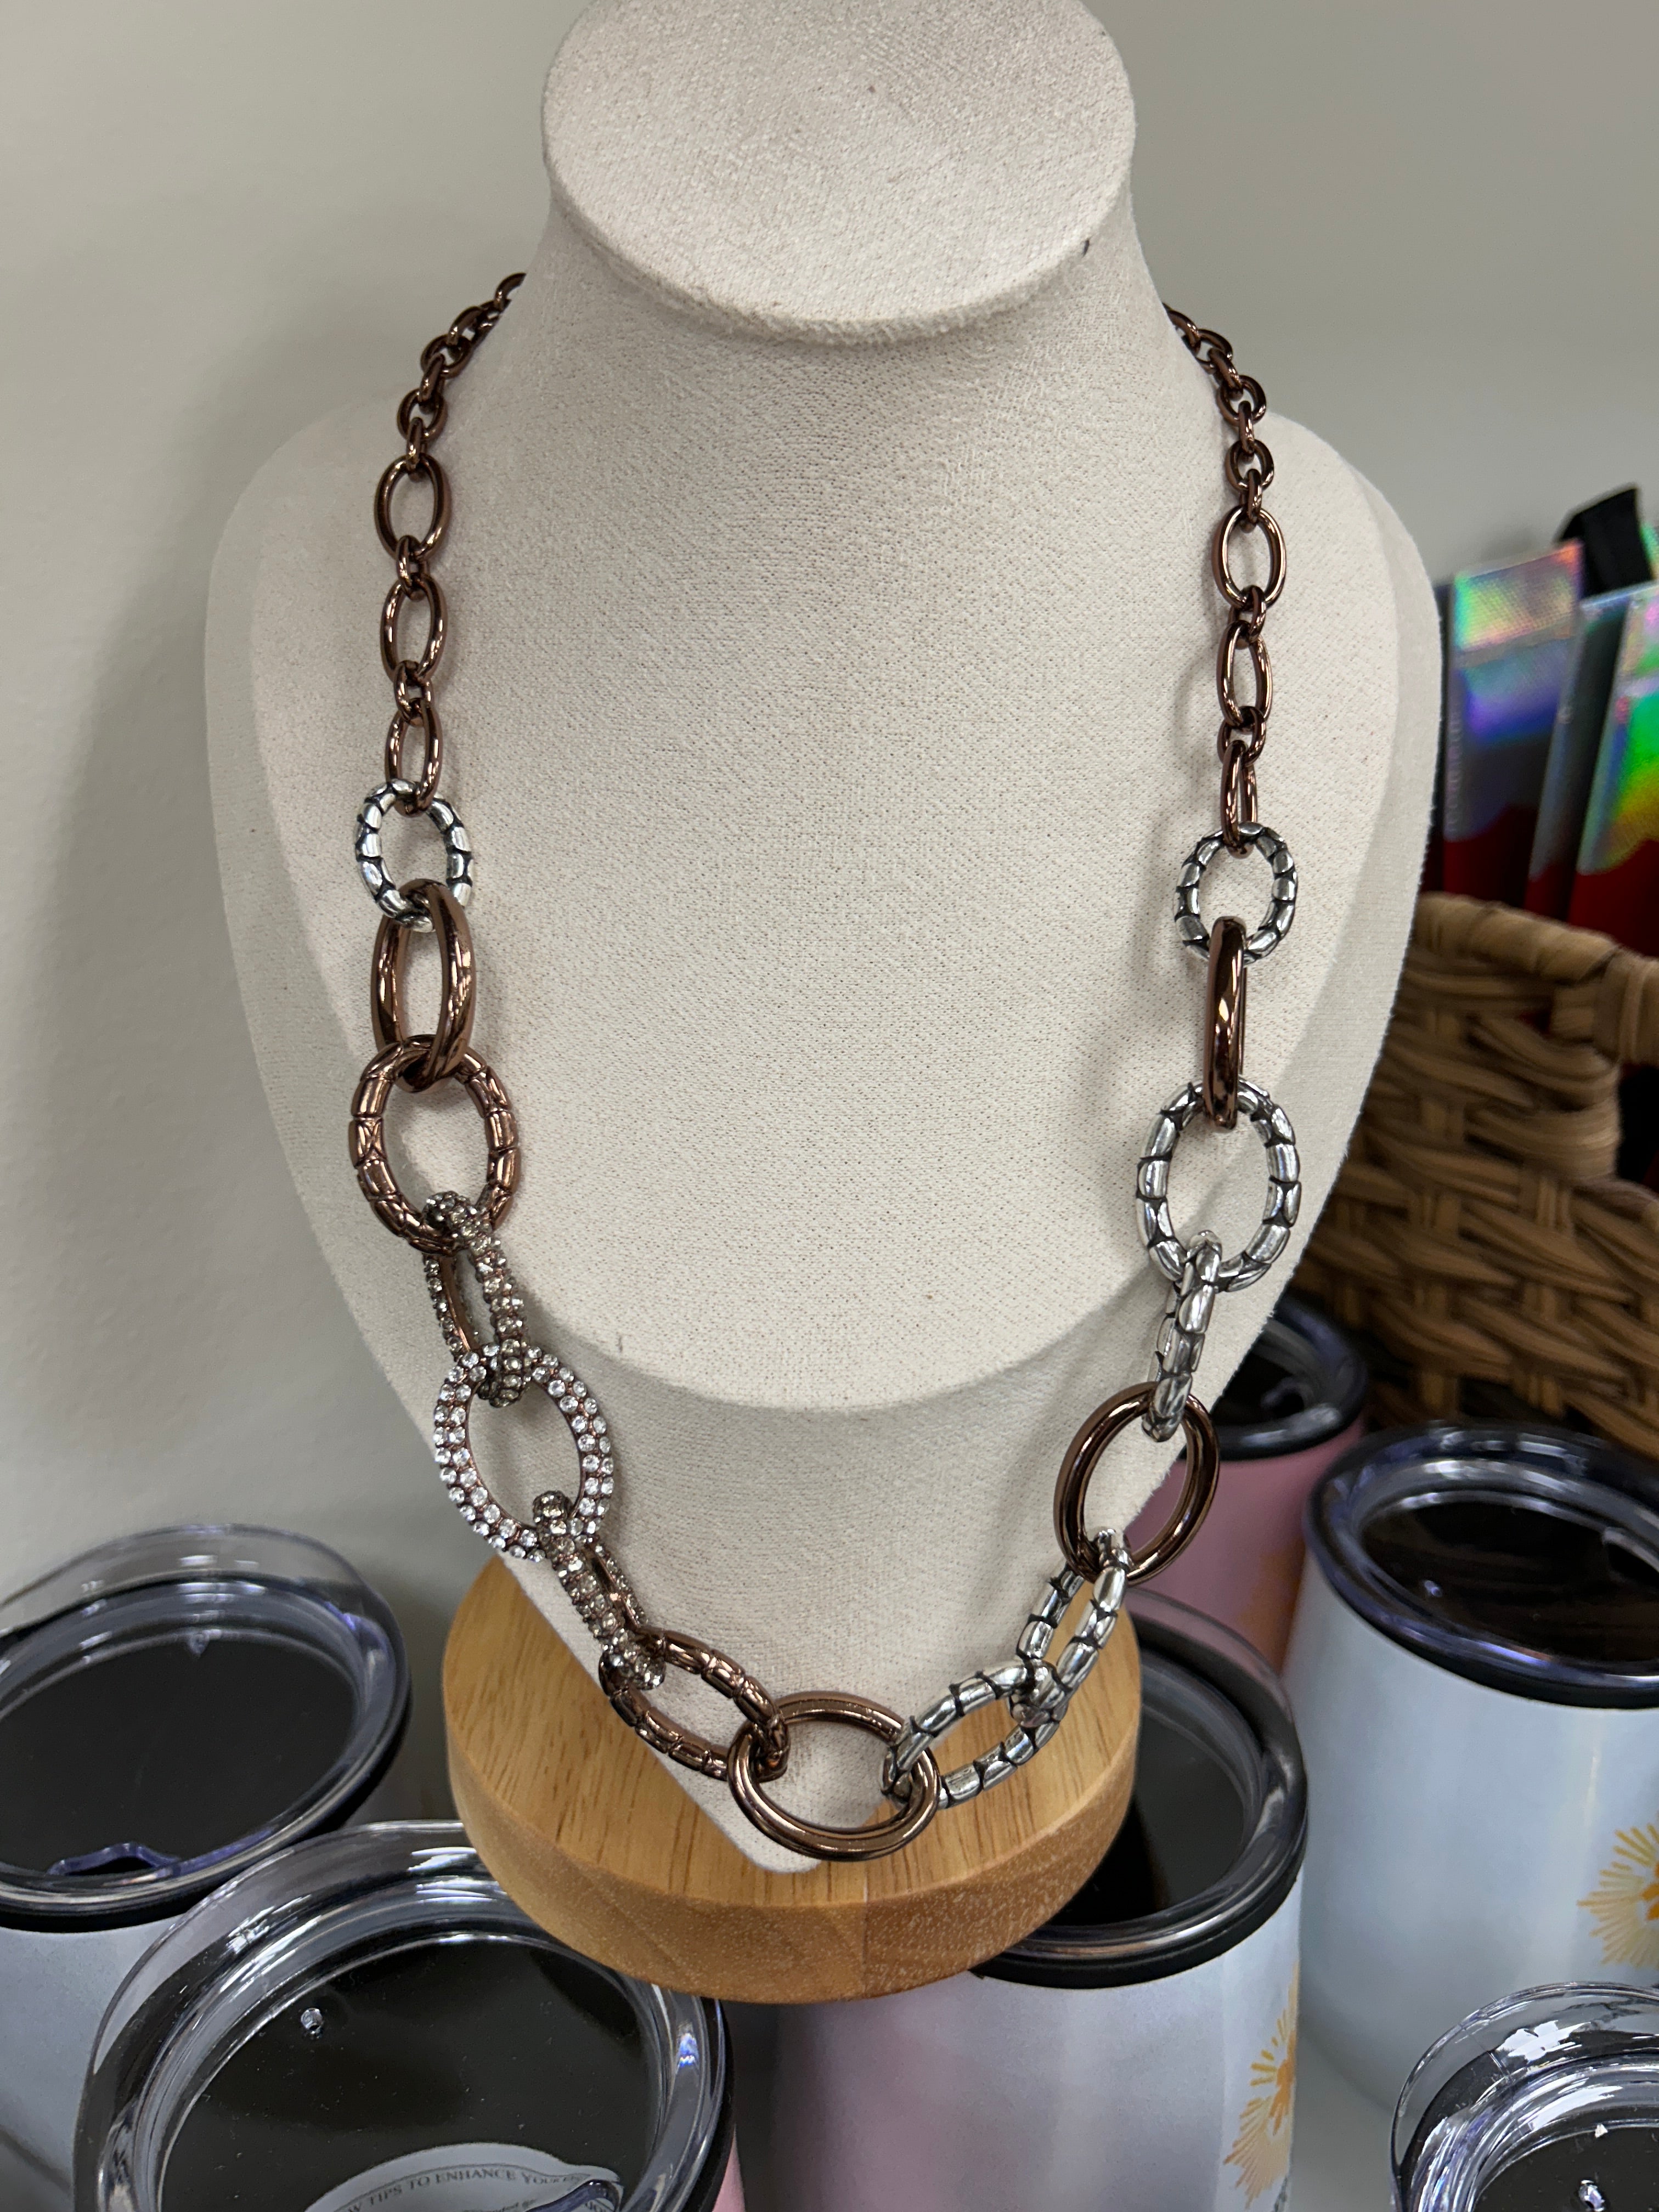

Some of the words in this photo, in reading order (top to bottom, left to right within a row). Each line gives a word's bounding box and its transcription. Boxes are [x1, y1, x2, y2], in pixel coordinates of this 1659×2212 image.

[368, 2185, 402, 2205] TIPS
[407, 2176, 431, 2190] TO
[436, 2168, 516, 2183] ENHANCE
